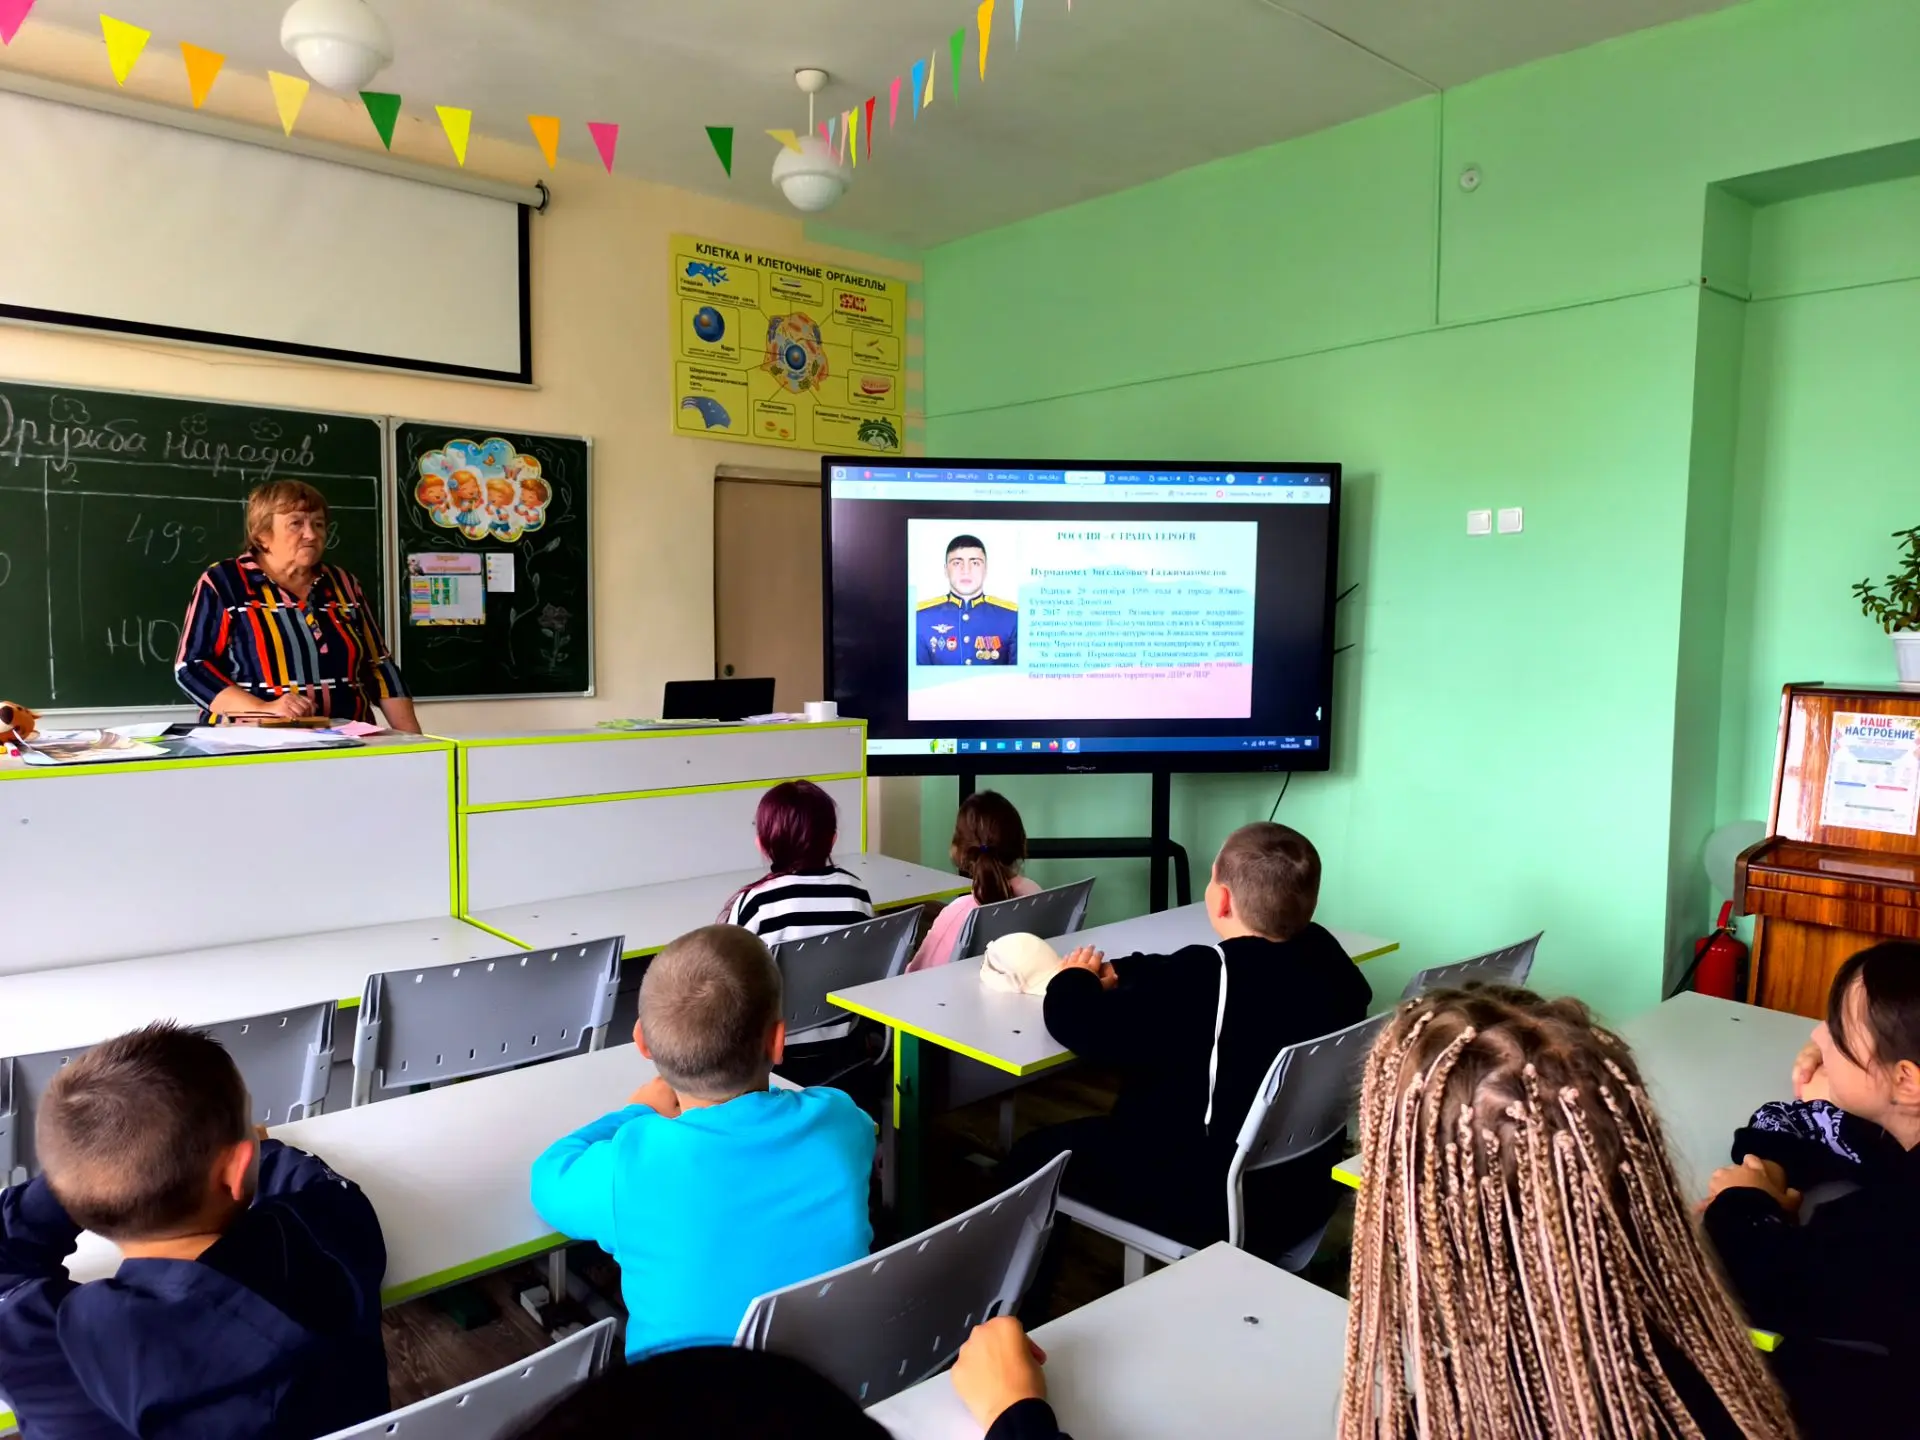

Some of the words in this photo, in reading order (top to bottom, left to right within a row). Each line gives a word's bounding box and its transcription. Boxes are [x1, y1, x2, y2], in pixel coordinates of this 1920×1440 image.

[696, 243, 740, 261] КЛЕТКА
[745, 253, 752, 263] И
[757, 256, 822, 278] КЛЕТОЧНЫЕ
[826, 271, 886, 291] ОРГАНЕЛЛЫ
[1057, 532, 1101, 541] РОССИЯ
[1111, 532, 1152, 541] СТРАНА
[1155, 532, 1197, 541] ГЕРОЕВ
[1860, 716, 1893, 728] НАШЕ
[1845, 726, 1916, 740] НАСТРОЕНИЕ
